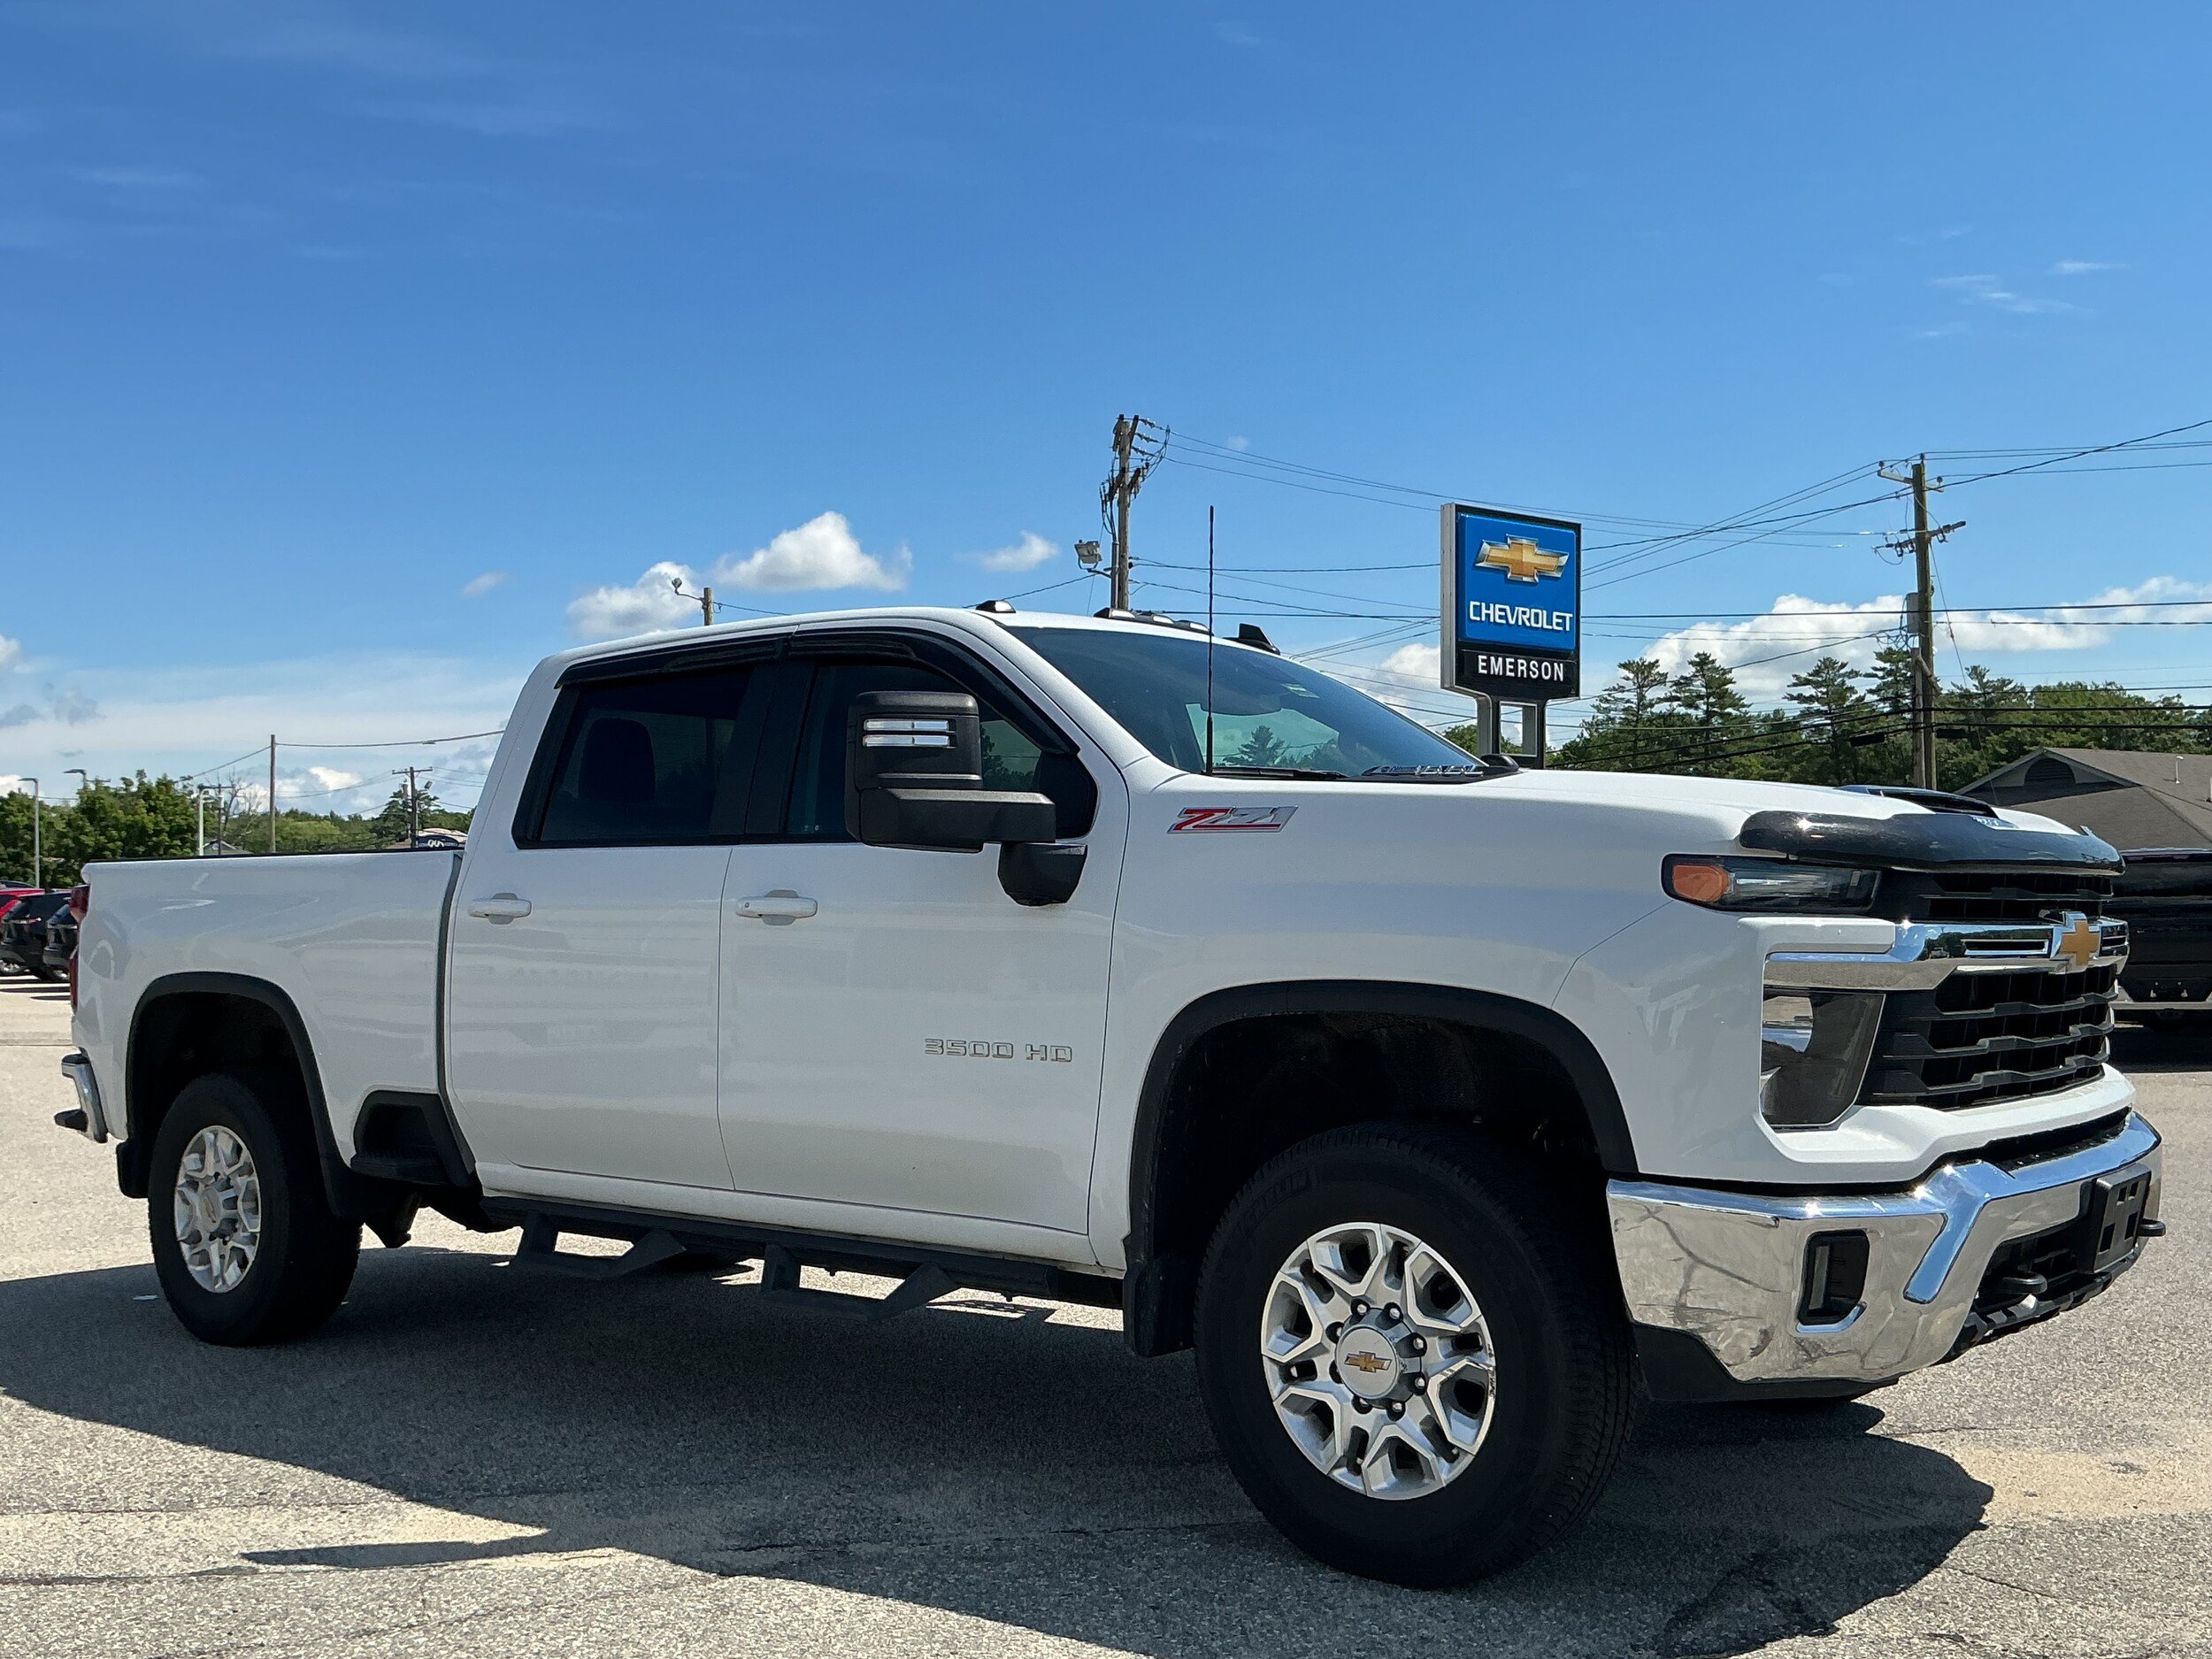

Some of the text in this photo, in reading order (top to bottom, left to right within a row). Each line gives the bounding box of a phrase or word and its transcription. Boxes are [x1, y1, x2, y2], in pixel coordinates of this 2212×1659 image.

[1469, 600, 1573, 632] CHEVROLET
[1477, 655, 1564, 682] EMERSON
[1167, 806, 1299, 834] Z71
[925, 1038, 1073, 1063] 3500 HD
